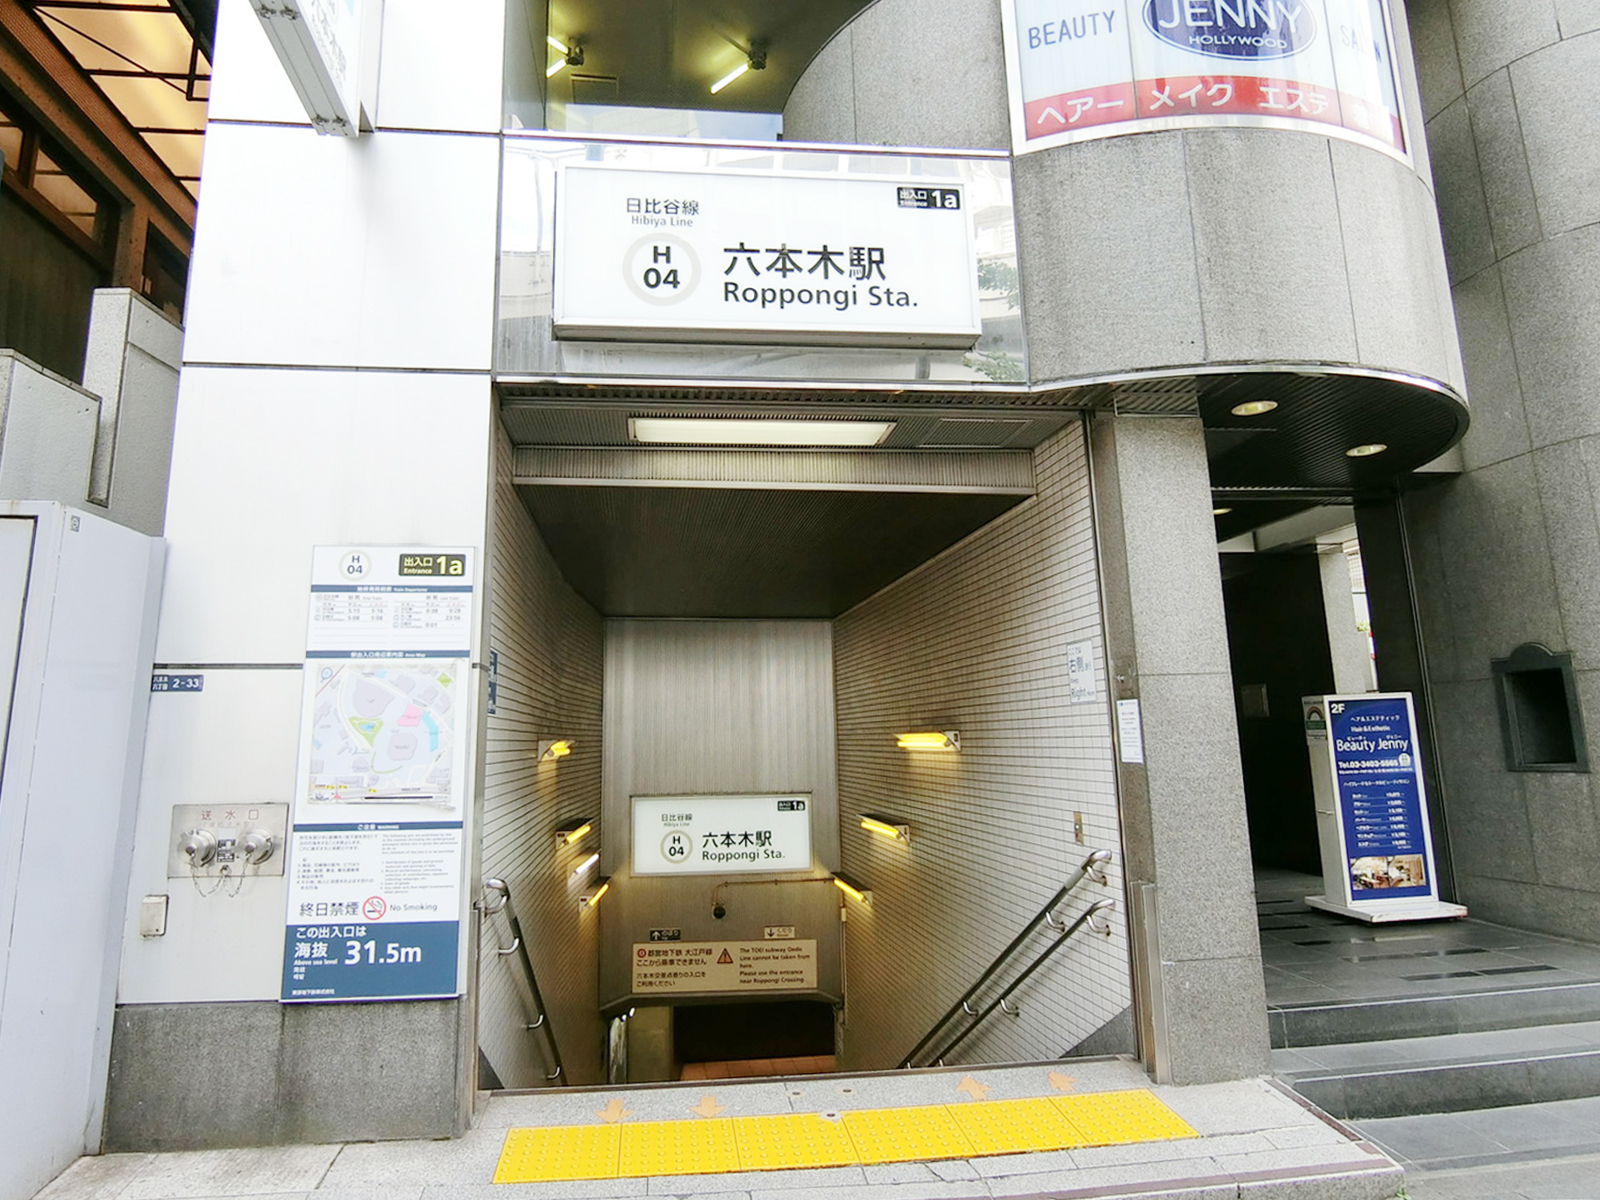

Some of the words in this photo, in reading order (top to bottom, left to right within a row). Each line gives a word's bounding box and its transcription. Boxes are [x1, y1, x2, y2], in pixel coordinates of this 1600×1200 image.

[1028, 10, 1115, 49] BEAUTY
[1158, 0, 1302, 33] JENNY
[1189, 35, 1288, 50] HOLLYWOOD
[1037, 96, 1124, 125] ヘアー
[1149, 83, 1234, 112] メイク
[1259, 86, 1328, 115] エステ
[900, 188, 927, 200] 出入口
[931, 189, 958, 208] 1a
[626, 197, 700, 216] 日比谷線
[631, 215, 667, 228] Hibiya
[670, 216, 694, 228] Line
[652, 246, 672, 264] H
[723, 242, 887, 281] 六本木駅
[643, 269, 681, 289] 04
[723, 281, 858, 311] Roppongi
[868, 285, 918, 307] Sta.
[351, 555, 360, 564] H
[404, 557, 433, 567] 出入口
[436, 556, 462, 575] 1a
[347, 565, 363, 575] 04
[172, 678, 199, 688] 2-33
[1331, 703, 1345, 714] 2F
[1336, 739, 1375, 753] Beauty
[1377, 738, 1408, 752] Jenny
[661, 813, 692, 822] 日比谷線
[672, 836, 681, 845] H
[702, 830, 772, 848] 六本木駅
[668, 847, 684, 857] 04
[702, 849, 760, 862] Roppongi
[764, 849, 785, 859] Sta.
[300, 902, 359, 917] 終日禁煙
[390, 904, 401, 912] No
[404, 903, 438, 912] Smoking
[296, 926, 367, 938] この出入口は
[294, 942, 329, 958] 海抜
[344, 940, 422, 965] 31.5m
